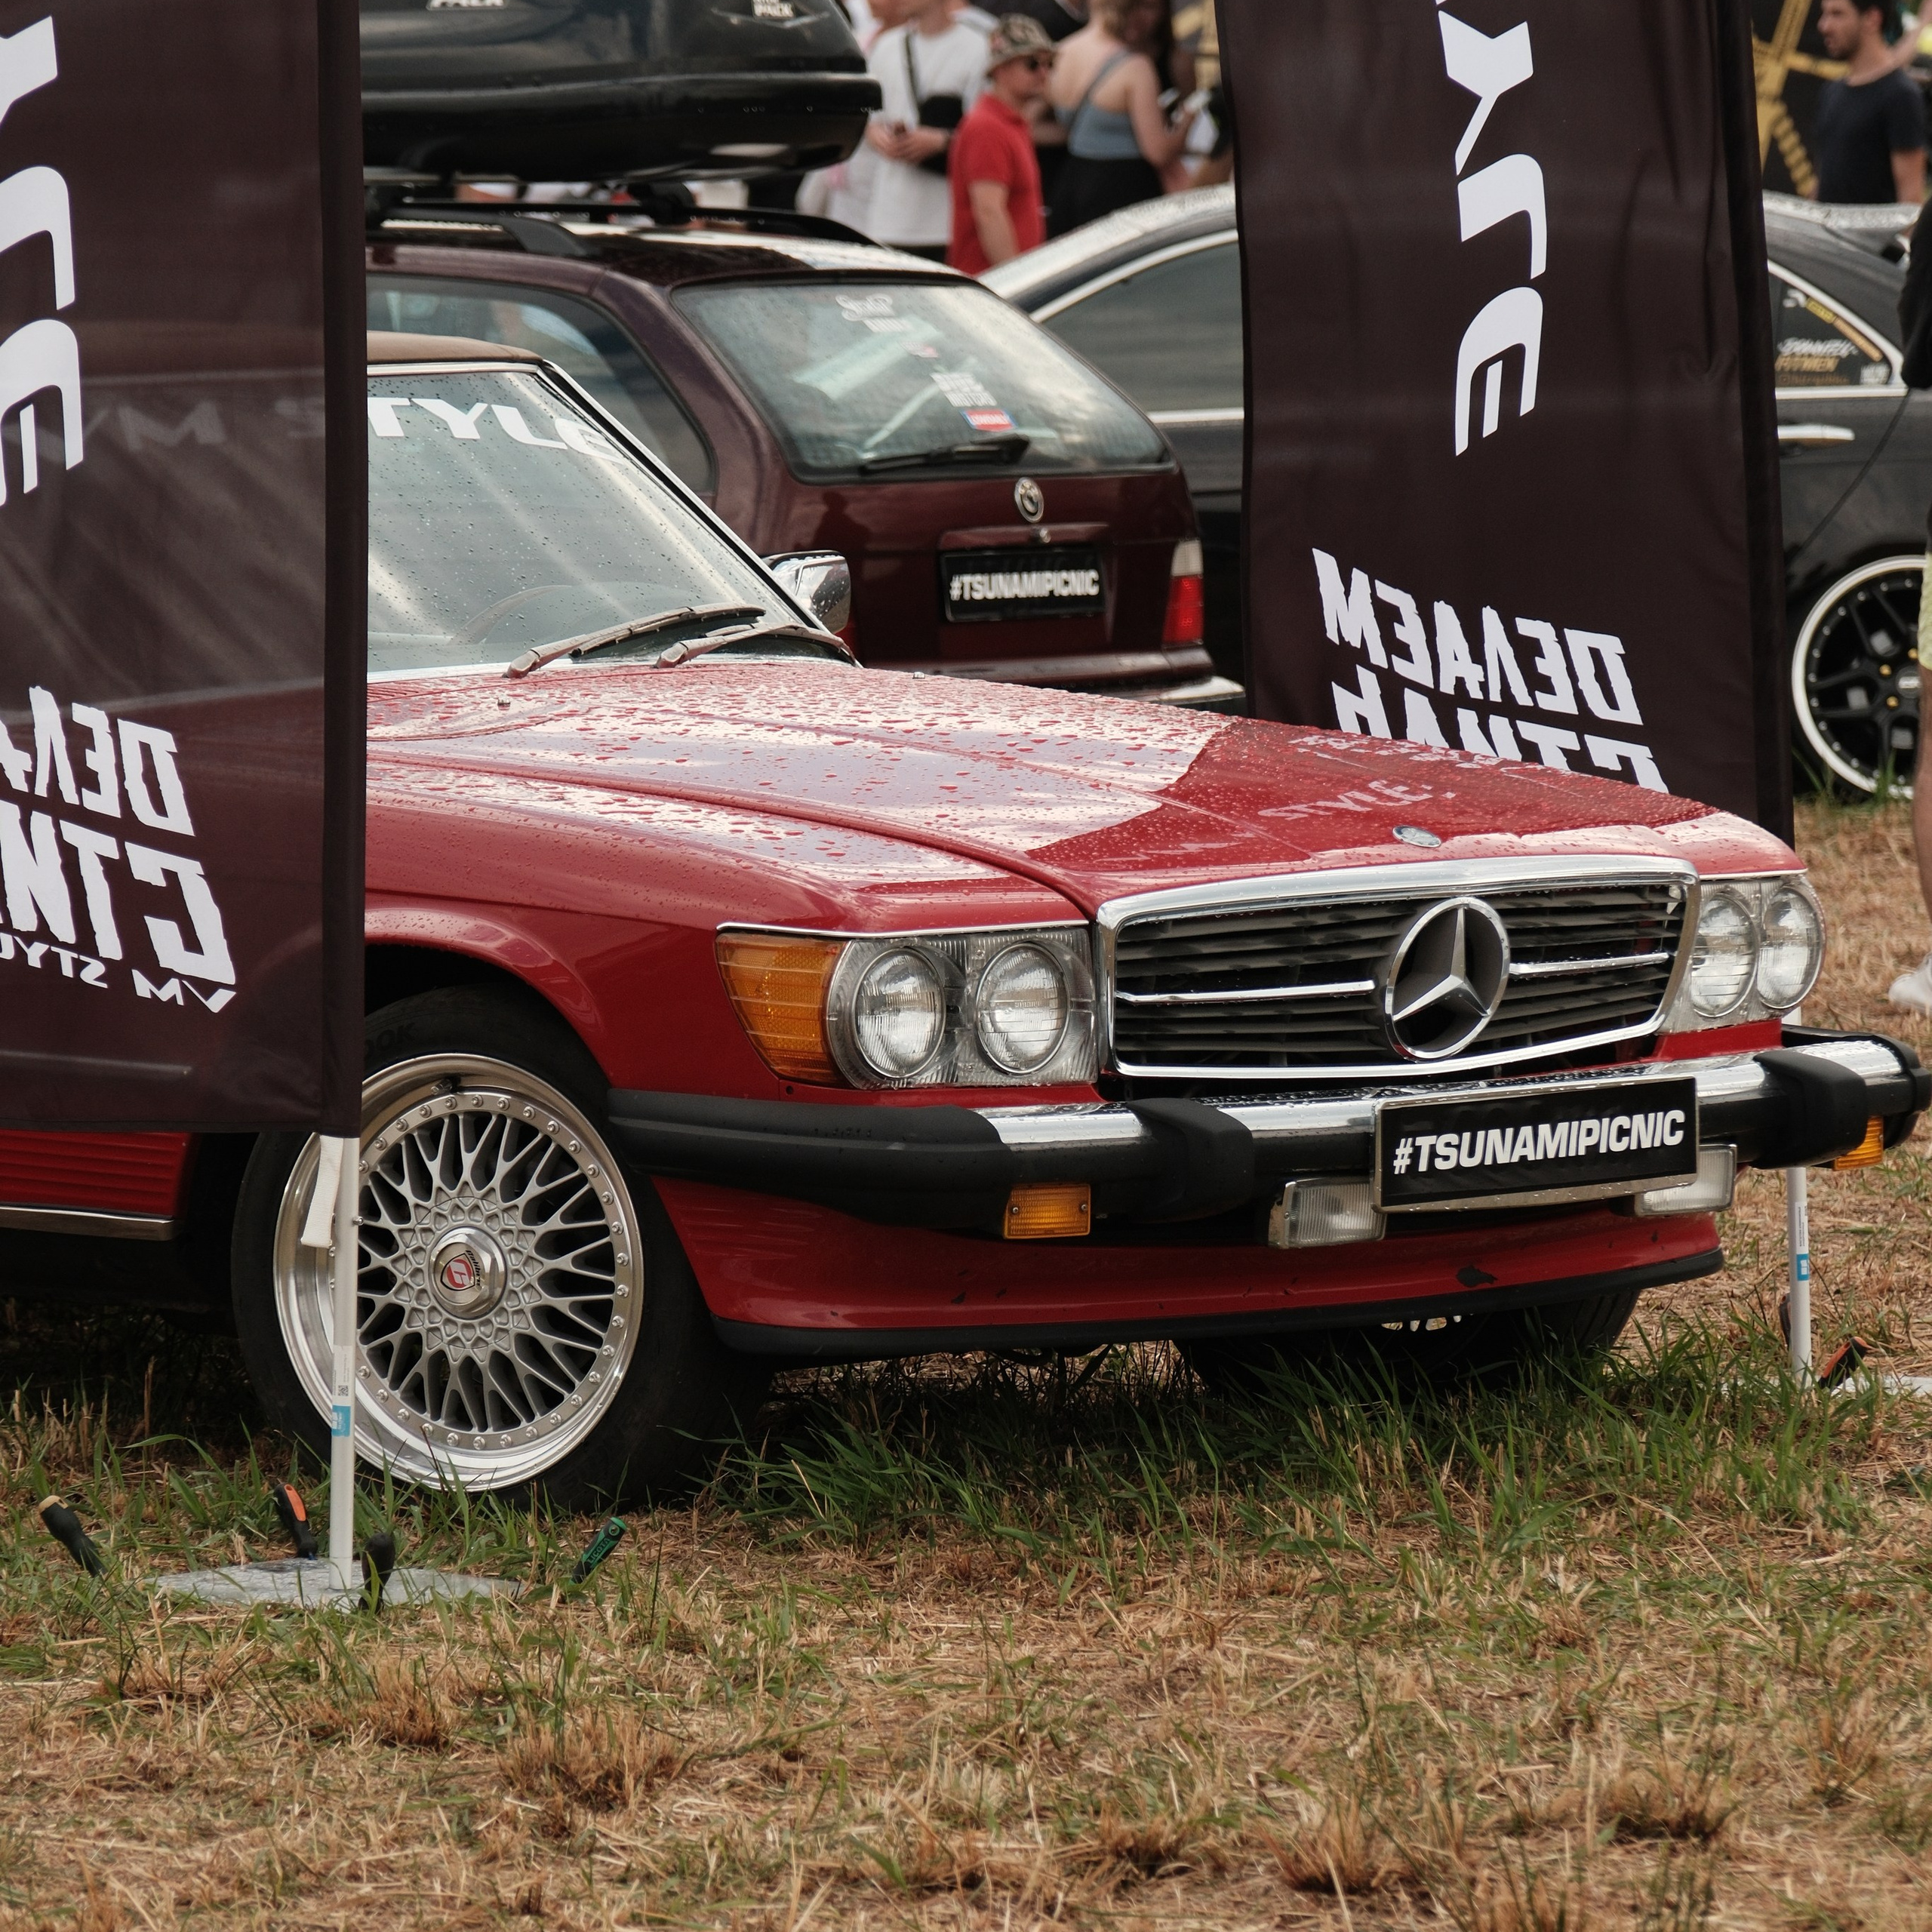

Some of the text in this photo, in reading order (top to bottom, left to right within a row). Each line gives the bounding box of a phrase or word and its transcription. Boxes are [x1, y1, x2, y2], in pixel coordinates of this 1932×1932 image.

[950, 570, 1100, 601] #TSUNAMIPICNIC
[1393, 1110, 1685, 1174] #TSUNAMIPICNIC
[587, 1537, 611, 1563] LICOTA
